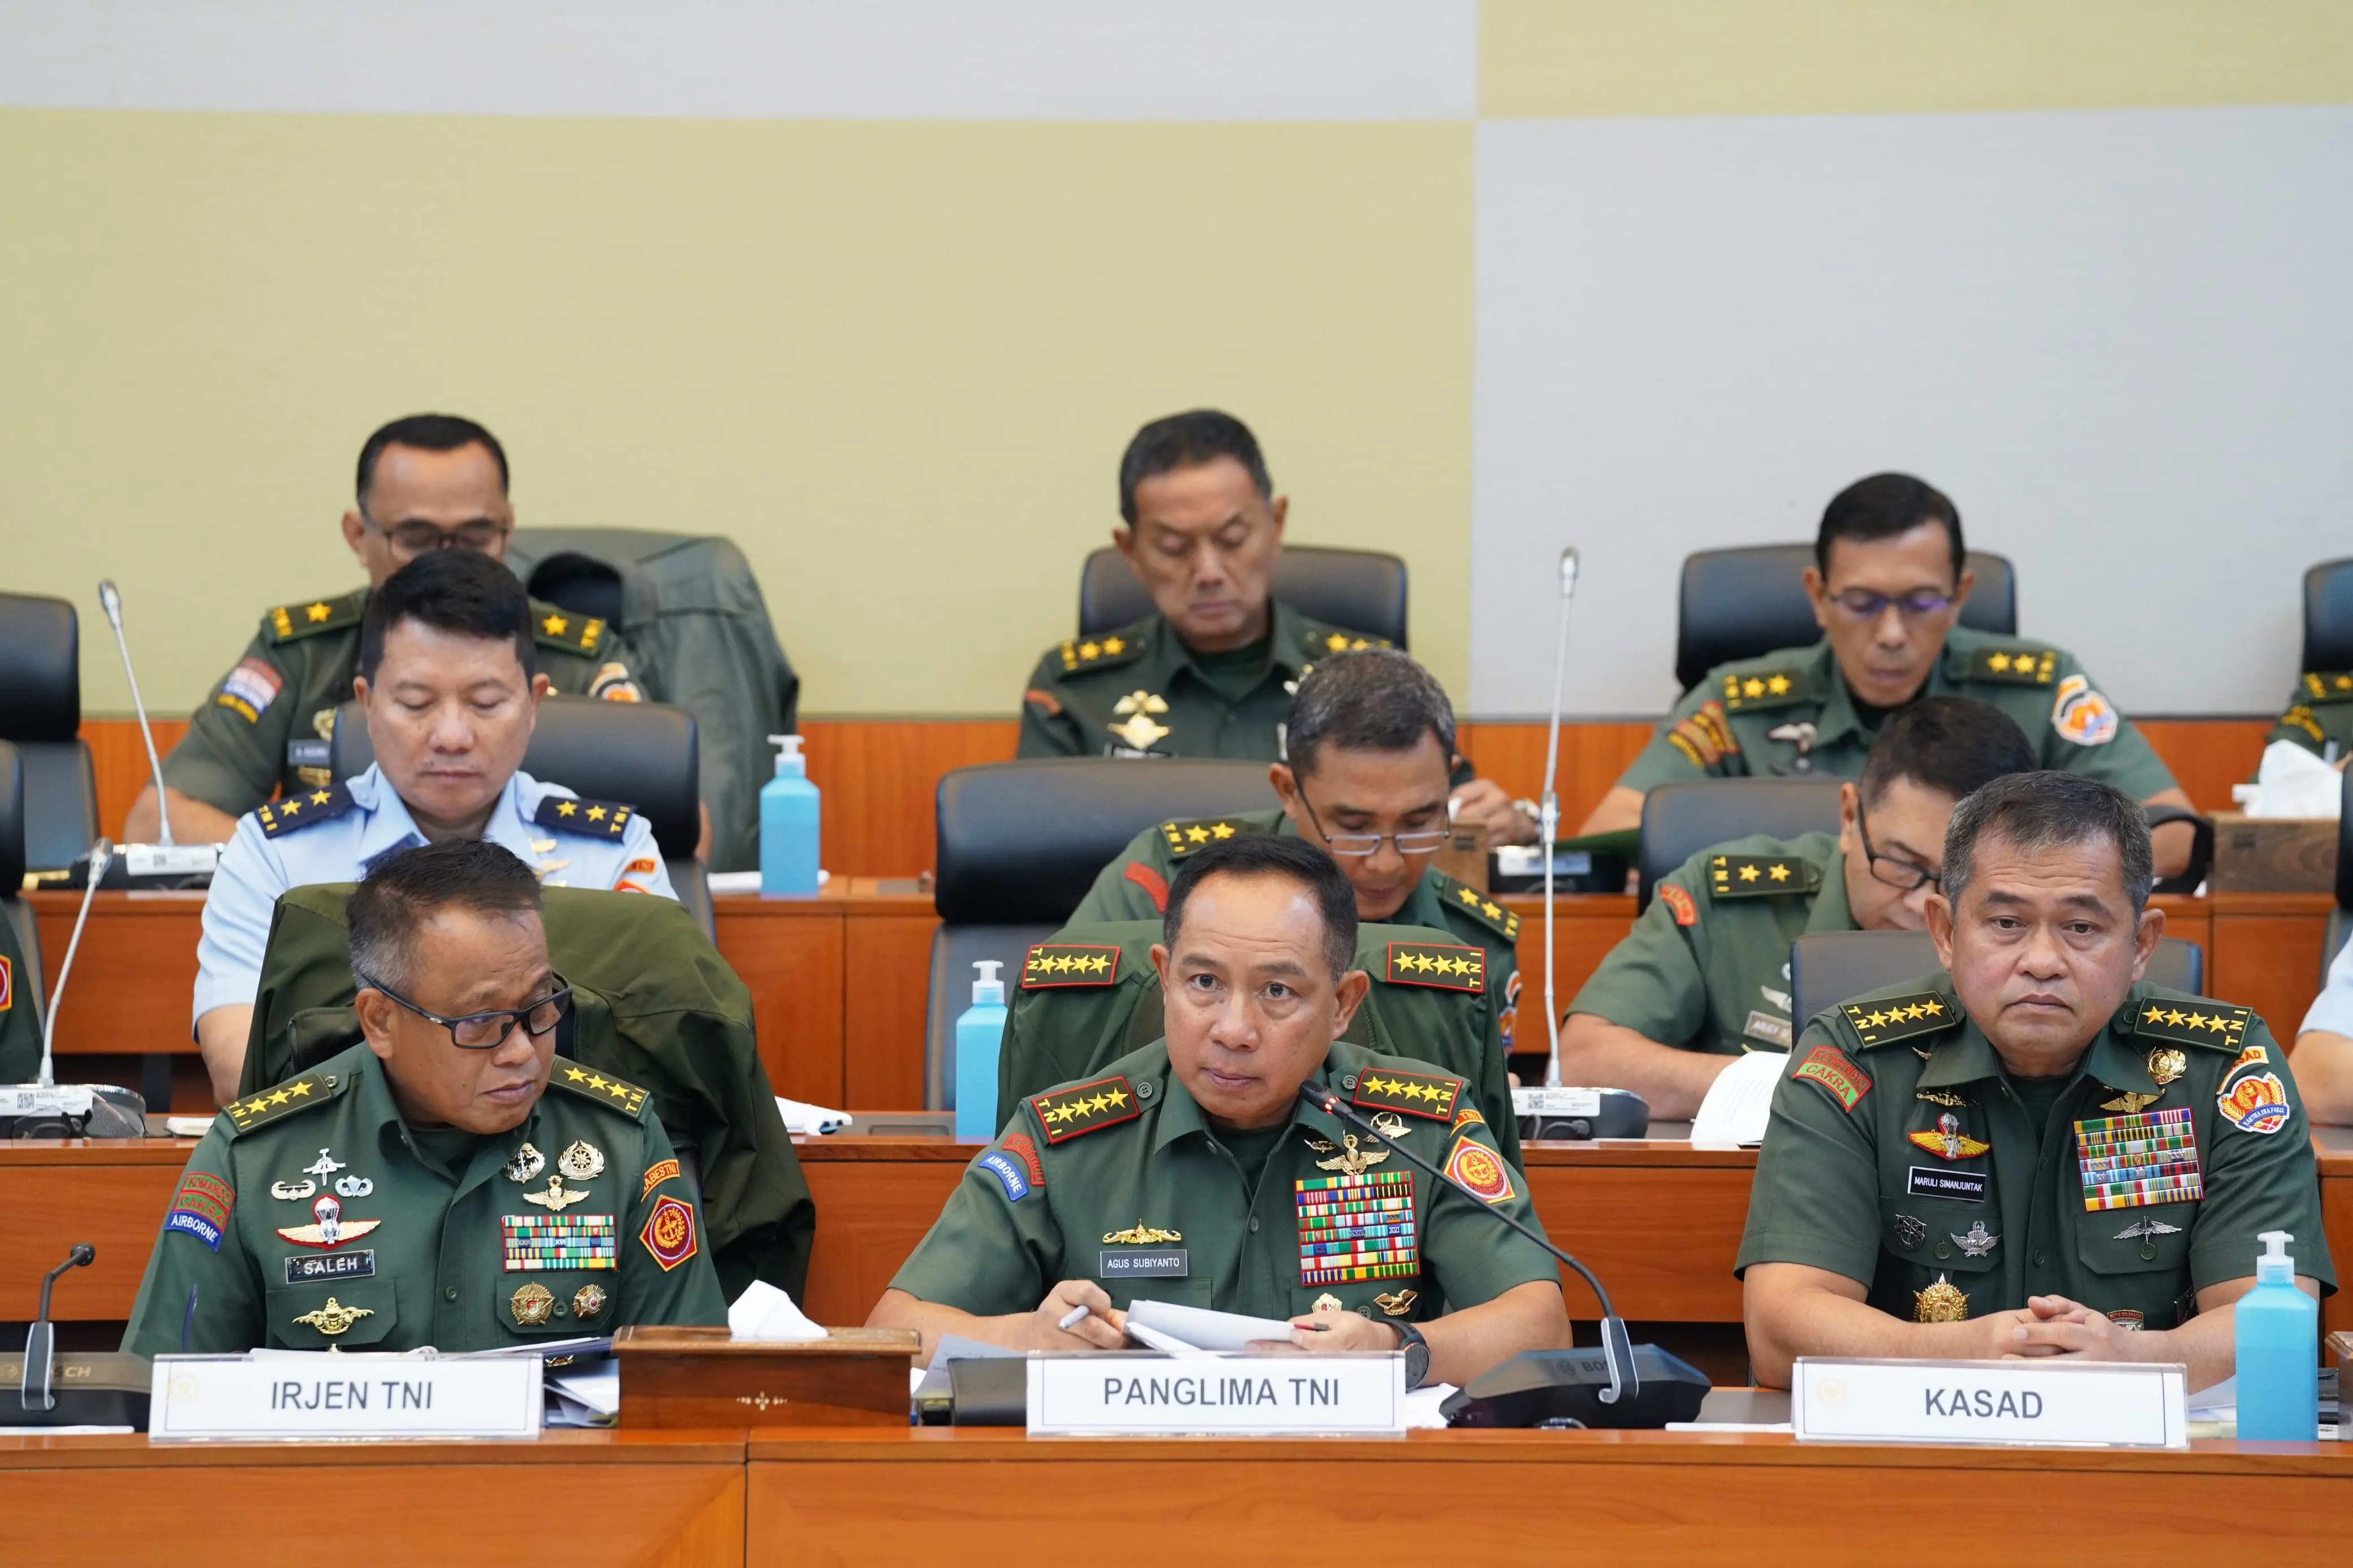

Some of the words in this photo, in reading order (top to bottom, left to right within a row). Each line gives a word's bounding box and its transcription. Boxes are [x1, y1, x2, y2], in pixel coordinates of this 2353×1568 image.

[1713, 856, 1730, 892] TNI
[1025, 947, 1044, 982] TNI
[1469, 952, 1482, 987] TNI
[1847, 1006, 1876, 1041] TNI
[2224, 1010, 2248, 1046] TNI
[1806, 1065, 1850, 1099] CAKRA
[625, 1087, 647, 1112] TNI
[1436, 1082, 1457, 1114] TNI
[229, 1102, 252, 1126] TNI
[1038, 1098, 1062, 1135] TNI
[985, 1155, 1023, 1193] AIRBORNE
[1914, 1176, 1938, 1187] MARULI
[1939, 1179, 1983, 1192] SIMANJUNTAK
[188, 1176, 232, 1203] KOMANDO
[180, 1195, 224, 1224] CAKRA
[170, 1213, 219, 1243] AIRBORNE
[1389, 1226, 1400, 1234] XVI
[304, 1257, 357, 1275] SALEH
[1107, 1259, 1130, 1269] AGUS
[1133, 1257, 1180, 1268] SUBIYANTO
[272, 1381, 368, 1409] IRJEN
[381, 1381, 432, 1409] TNI
[1104, 1377, 1278, 1405] PANGLIMA
[1288, 1379, 1339, 1406] TNI
[1925, 1388, 2043, 1419] KASAD
